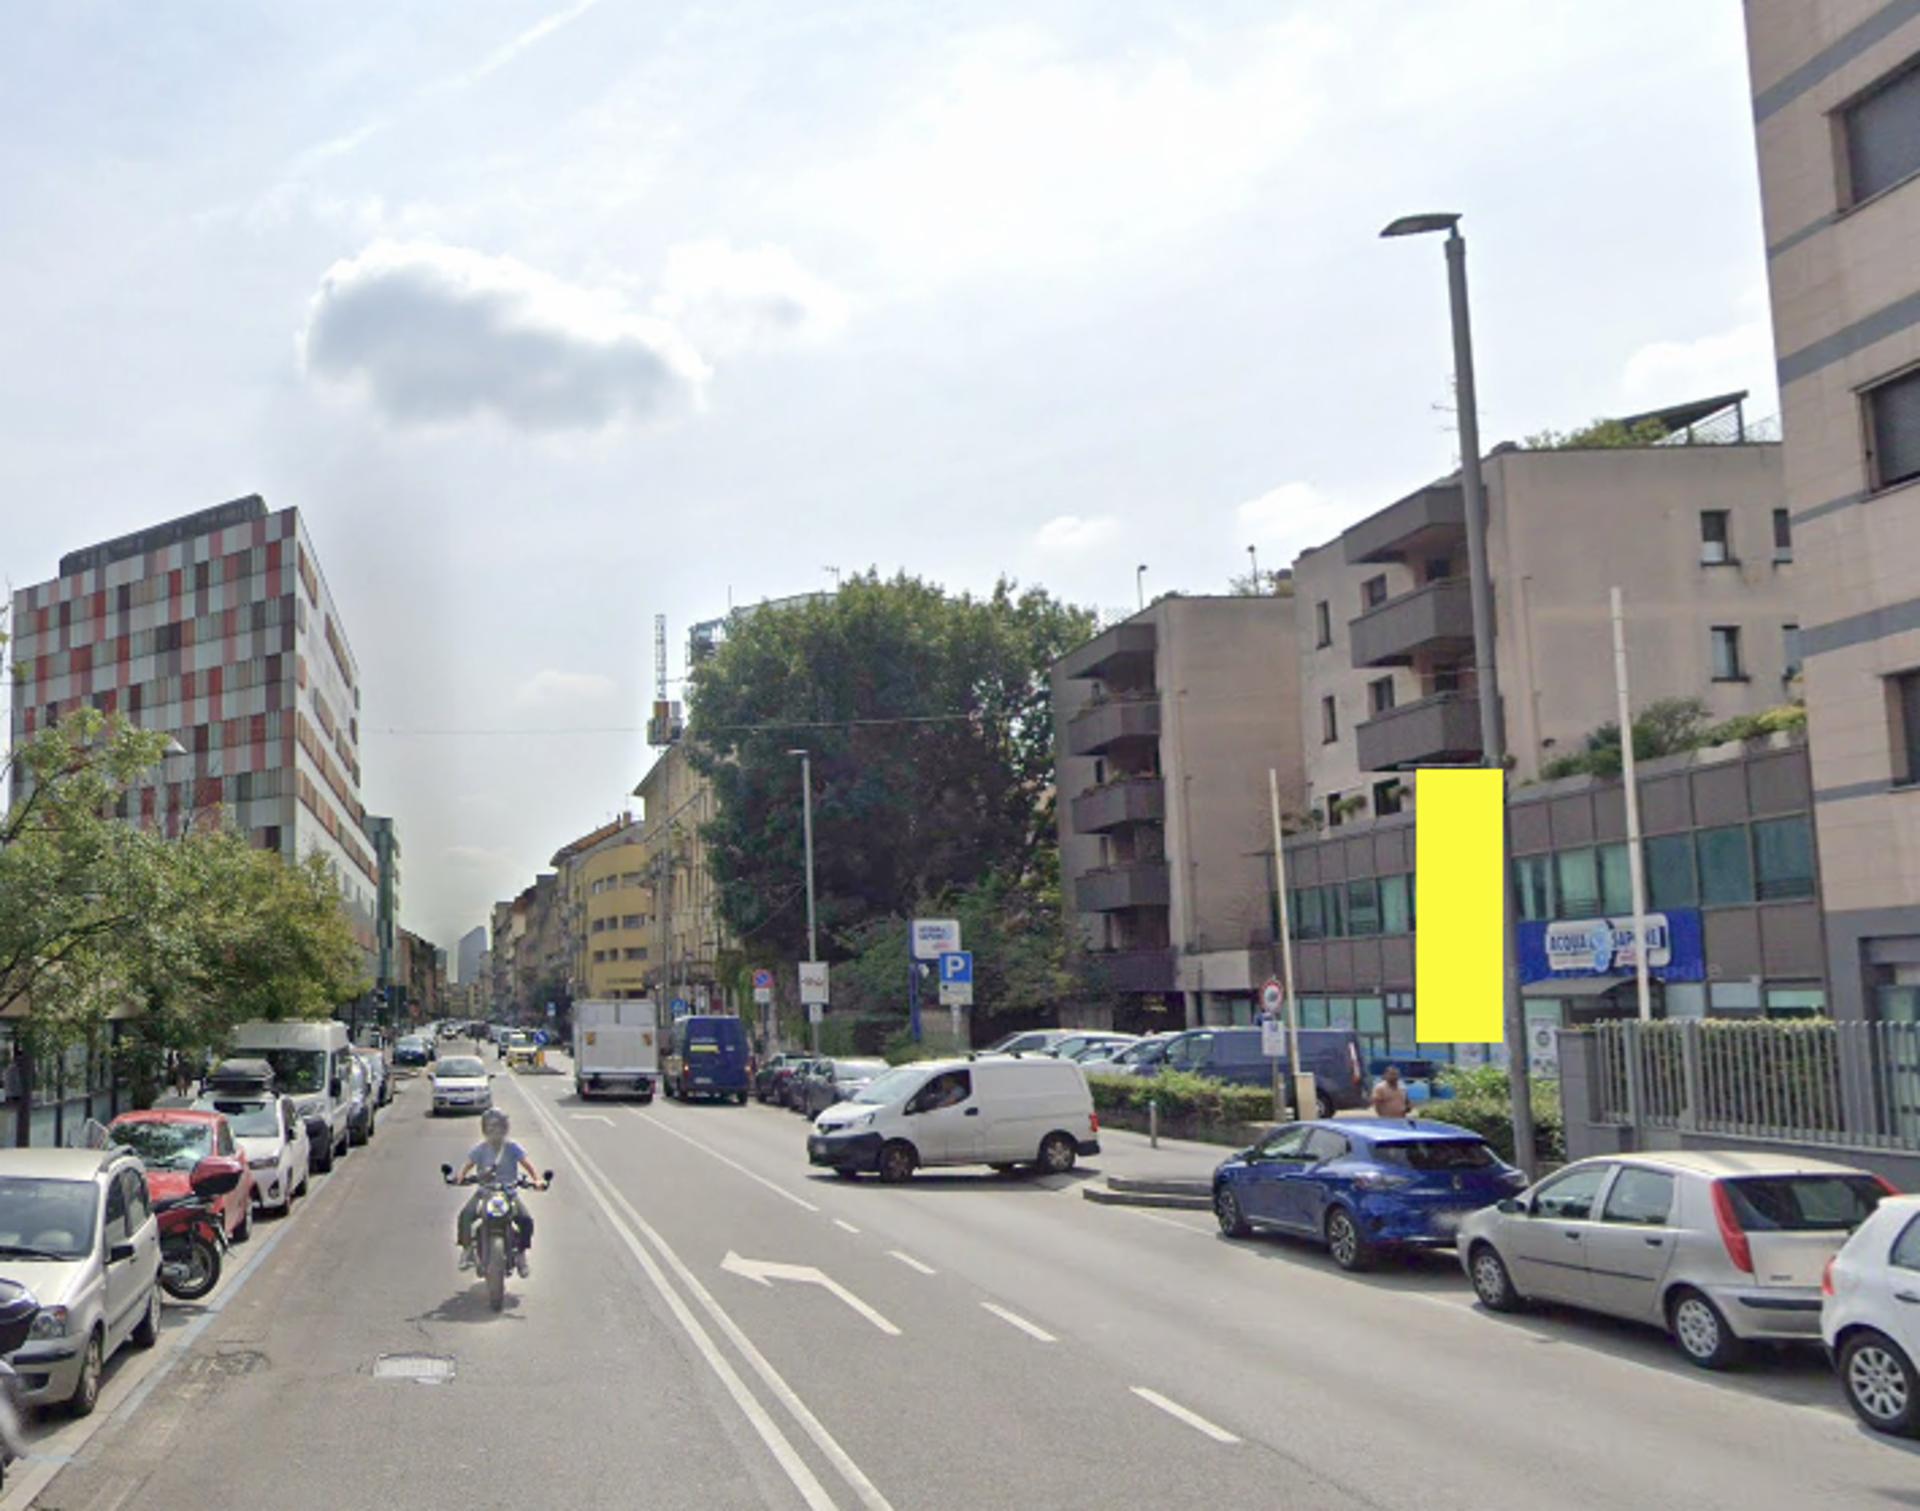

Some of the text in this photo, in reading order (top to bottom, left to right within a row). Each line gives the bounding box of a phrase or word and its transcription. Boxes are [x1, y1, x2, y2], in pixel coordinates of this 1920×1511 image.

[1550, 934, 1587, 951] ACQUA
[1611, 929, 1658, 948] SAPNE
[946, 955, 965, 979] P
